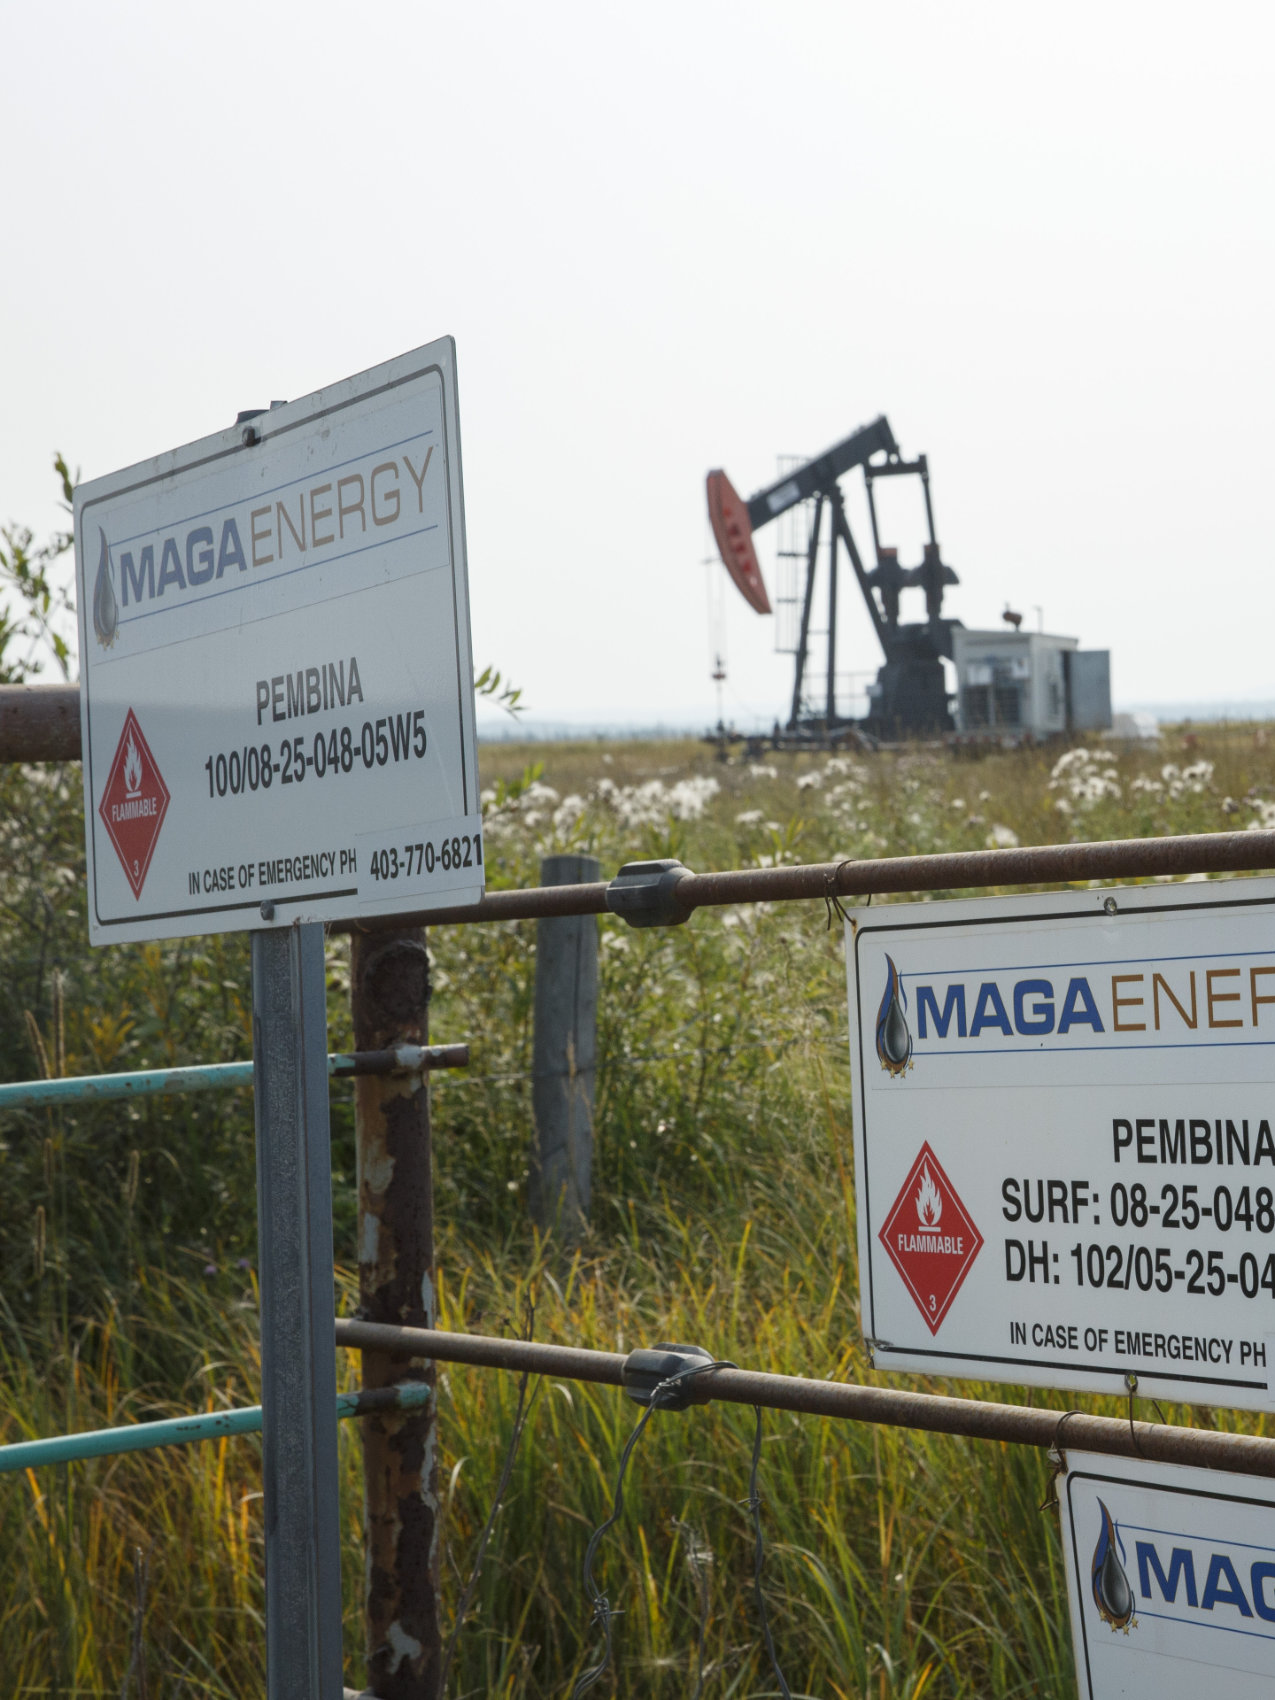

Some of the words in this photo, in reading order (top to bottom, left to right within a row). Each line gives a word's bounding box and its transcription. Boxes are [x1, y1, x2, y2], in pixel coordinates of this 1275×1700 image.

[256, 656, 364, 726] PEMBINA
[205, 709, 427, 798] 100/08-25-048-05W5
[112, 797, 157, 822] FLAMMABLE
[133, 859, 139, 877] 3
[188, 872, 200, 895] IN
[203, 866, 234, 893] CASE
[238, 864, 254, 889] OF
[259, 851, 336, 886] EMERGENCY
[340, 848, 357, 875] PH
[370, 833, 483, 881] 403-770-6821
[1001, 1178, 1100, 1225] SURF:
[898, 1234, 964, 1255] FLAMMABLE
[1005, 1239, 1060, 1285] DH:
[929, 1294, 937, 1312] 3
[1010, 1321, 1027, 1345] IN
[1032, 1323, 1079, 1350] CASE
[1084, 1327, 1109, 1353] OF
[1114, 1330, 1233, 1364] EMERGENCY
[1240, 1340, 1266, 1367] PH
